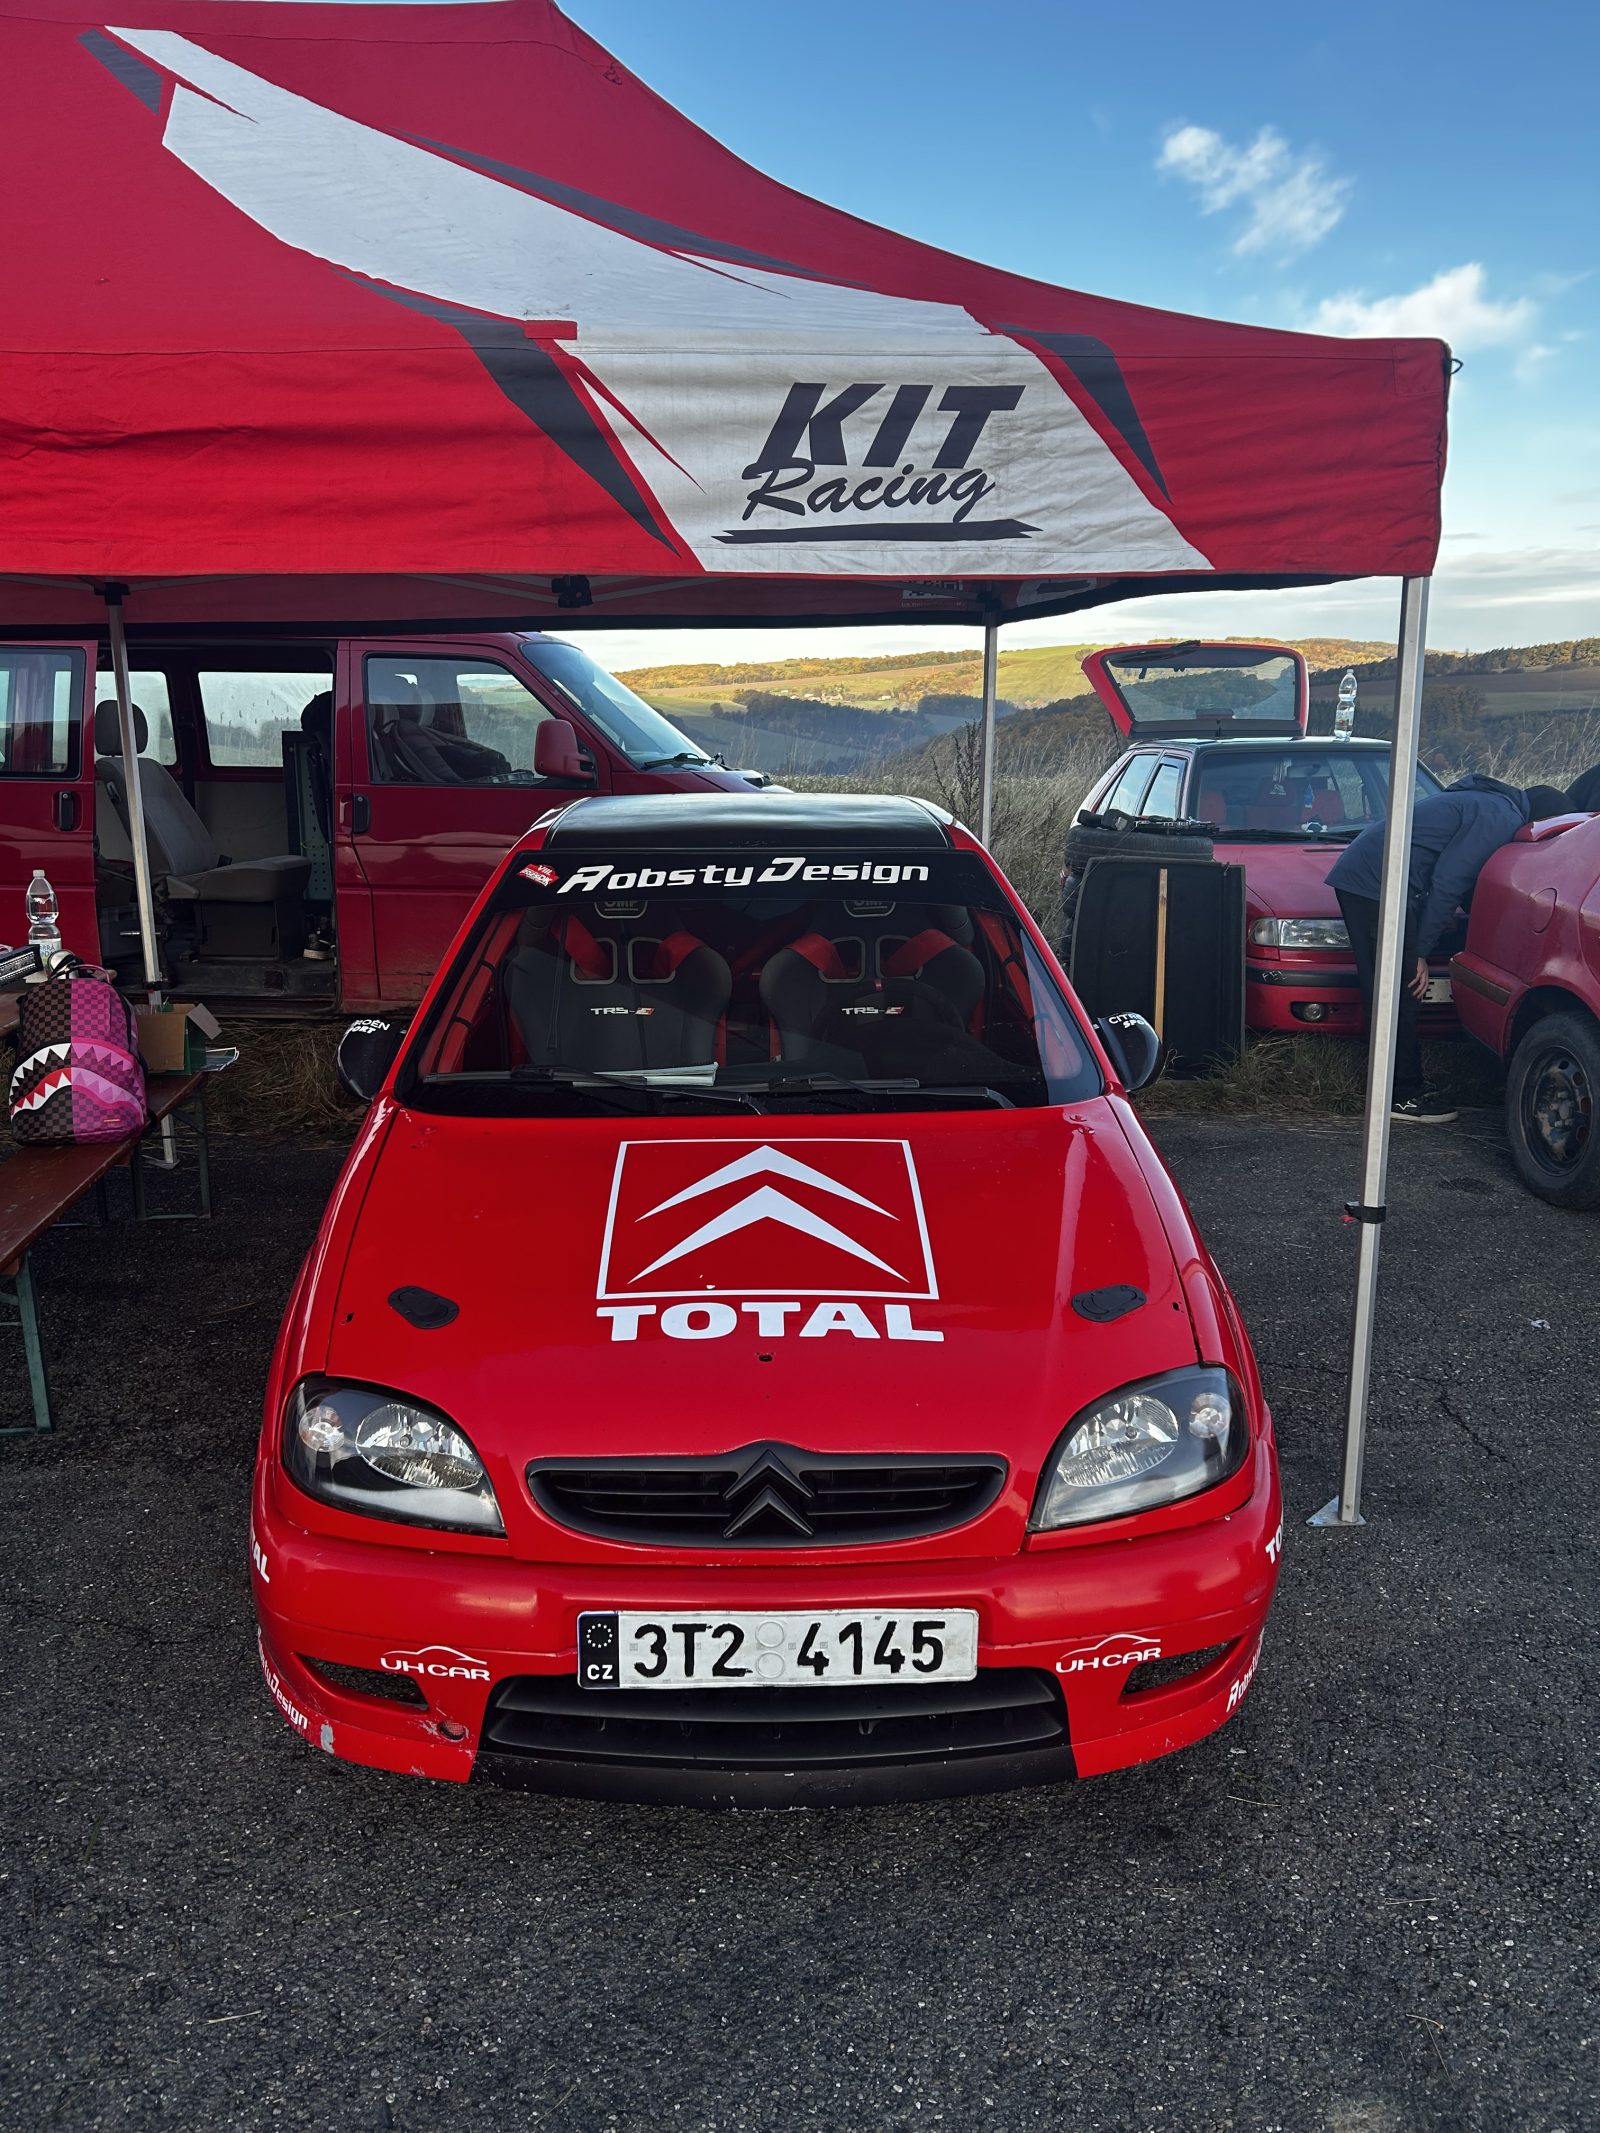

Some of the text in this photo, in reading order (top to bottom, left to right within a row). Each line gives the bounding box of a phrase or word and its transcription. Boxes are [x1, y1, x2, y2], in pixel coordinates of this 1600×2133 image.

[757, 382, 1026, 469] KIT
[742, 457, 996, 523] Racing
[597, 1302, 945, 1342] TOTAL
[586, 1620, 946, 1681] CZ 3T2 4145
